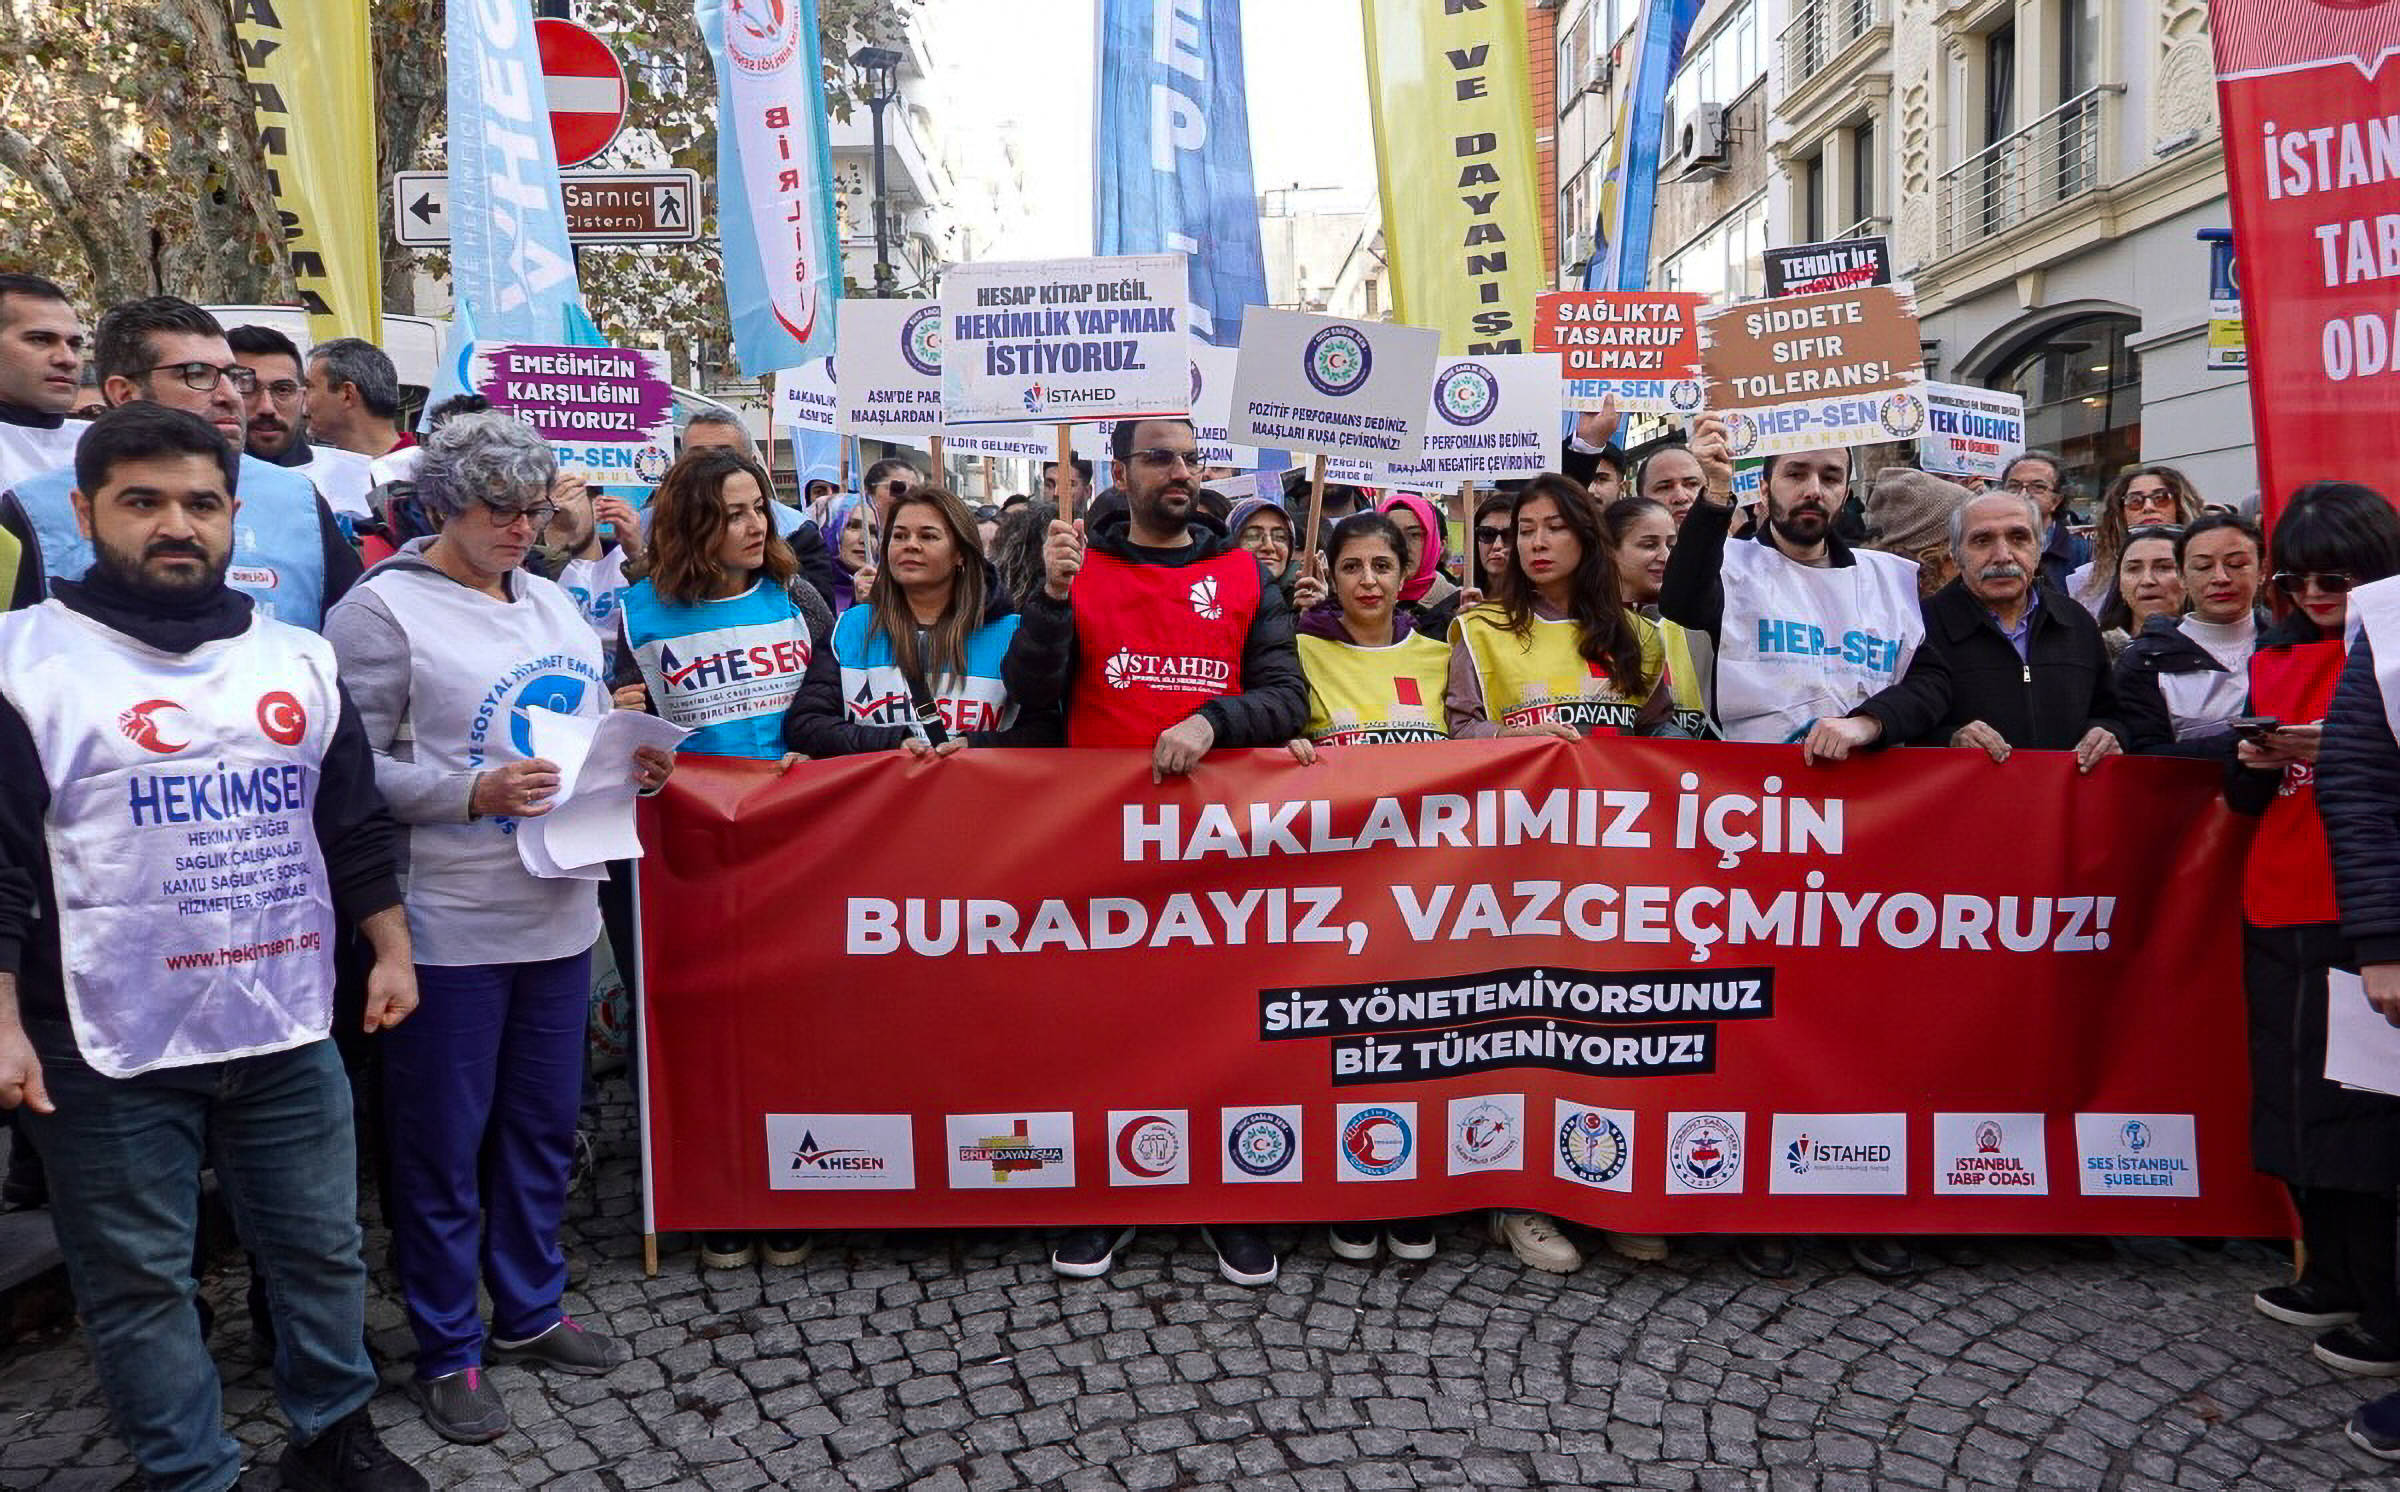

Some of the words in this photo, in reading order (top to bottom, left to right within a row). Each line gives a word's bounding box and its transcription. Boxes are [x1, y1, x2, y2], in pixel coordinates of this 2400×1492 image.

[1444, 42, 1490, 101] VE
[1780, 249, 1847, 280] TEHDİT
[977, 287, 1036, 307] HESAP
[1040, 281, 1093, 304] KİTAP
[1097, 278, 1153, 302] DEĞİL,
[955, 307, 1071, 340] HEKİMLİK
[1075, 307, 1176, 335] YAPMAK
[1559, 299, 1681, 322] SAĞLIKTA
[1745, 301, 1863, 339] ŞİDDETE
[1554, 326, 1684, 346] TASARRUF
[1772, 335, 1843, 363] SIFIR
[509, 352, 635, 378] EMEĞİMİZİN
[986, 338, 1146, 376] İSTİYORUZ.
[1570, 350, 1663, 369] OLMAZ!
[1570, 380, 1665, 398] HEP-SEN
[1732, 360, 1890, 399] TOLERANS!
[507, 381, 640, 405] KARŞILIĞINI
[917, 390, 942, 404] PAR
[1046, 387, 1116, 403] İSTAHED
[513, 403, 635, 430] İSTİYORUZ!
[851, 409, 935, 426] MAAŞLARDAN
[1249, 401, 1291, 418] POZİTİF
[1292, 406, 1363, 428] PERFORMANS
[1758, 400, 1878, 436] HEP-SEN
[1929, 409, 1959, 434] TEK
[1962, 410, 2021, 444] ÖDEME!
[943, 436, 978, 450] ILDIR
[1252, 421, 1305, 440] MAAŞLARI
[1307, 428, 1336, 447] KUŞA
[1432, 434, 1496, 450] PERFORMANS
[1499, 429, 1541, 450] DEDİNİZ,
[551, 447, 633, 468] P-SEN
[1439, 453, 1485, 473] NEGATİFE
[1732, 472, 1760, 492] HE
[511, 655, 564, 682] HİZMET
[473, 677, 513, 743] SOSYAL
[847, 676, 1005, 733] AHSEN
[469, 747, 485, 768] VE
[1122, 788, 1651, 862] HAKLARIMIZ
[1676, 772, 1844, 869] İÇİN
[236, 827, 252, 843] VE
[163, 878, 207, 896] KAMU
[178, 893, 253, 916] HİZMETLER
[845, 885, 1371, 956] BURADAYIZ,
[1391, 870, 2117, 963] VAZGEÇMİYORUZ!
[167, 931, 320, 971] www.hekimsen.org
[1265, 991, 1329, 1031] SİZ
[1338, 969, 1762, 1024] YÖNETEMİYORSUNUZ
[1336, 1036, 1403, 1075] BİZ
[1412, 1020, 1705, 1066] TÜKENİYORUZ!
[791, 1129, 884, 1170] AHESEN
[1814, 1140, 1891, 1162] İSTAHED
[2087, 1157, 2114, 1171] SES
[2117, 1154, 2189, 1171] İSTANBUL
[1956, 1157, 2024, 1171] İSTANBUL
[1989, 1170, 2035, 1186] ODASI
[2104, 1170, 2173, 1188] ŞUBELERİ
